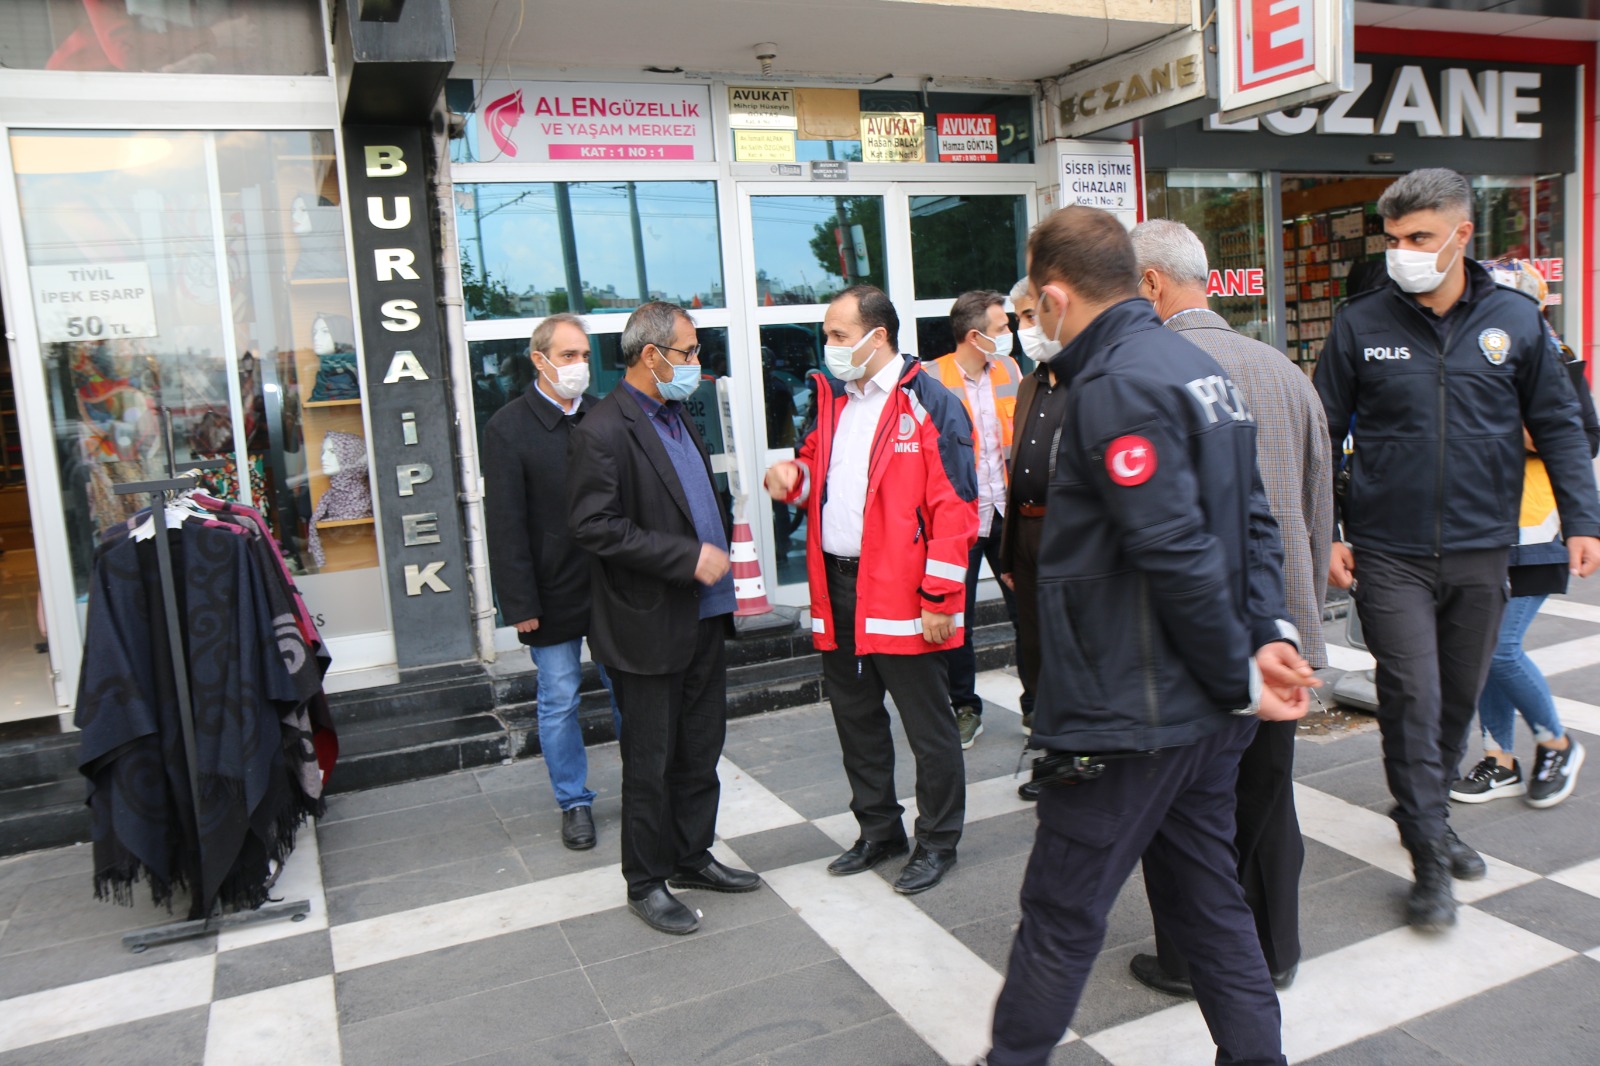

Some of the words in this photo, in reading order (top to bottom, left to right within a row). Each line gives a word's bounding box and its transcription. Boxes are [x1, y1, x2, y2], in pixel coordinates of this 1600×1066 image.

[1252, 0, 1304, 74] E
[733, 90, 789, 101] AVUKAT
[1060, 54, 1198, 127] ECZANE
[535, 97, 607, 117] ALEN
[608, 99, 700, 118] GÜZELLİK
[1203, 63, 1542, 138] ZANE
[541, 123, 563, 136] VE
[567, 123, 624, 139] YAŞAM
[867, 117, 917, 136] AVUKAT
[943, 117, 992, 135] AVUKAT
[867, 137, 893, 148] Hasan
[894, 137, 919, 148] BALAY
[942, 140, 965, 151] Hamza
[966, 140, 994, 153] GÖKTAŞ
[580, 147, 606, 157] KAT
[628, 148, 648, 157] NO
[1065, 160, 1095, 175] SİSER
[1098, 160, 1132, 178] İŞİTME
[1072, 178, 1127, 193] CİHAZLARI
[1100, 196, 1114, 206] No:
[1117, 197, 1124, 207] 2
[68, 267, 115, 282] TİVİL
[41, 290, 85, 304] İPEK
[89, 287, 145, 304] EŞARP
[66, 315, 103, 338] 50
[110, 323, 132, 335] TL
[894, 442, 919, 453] MKE
